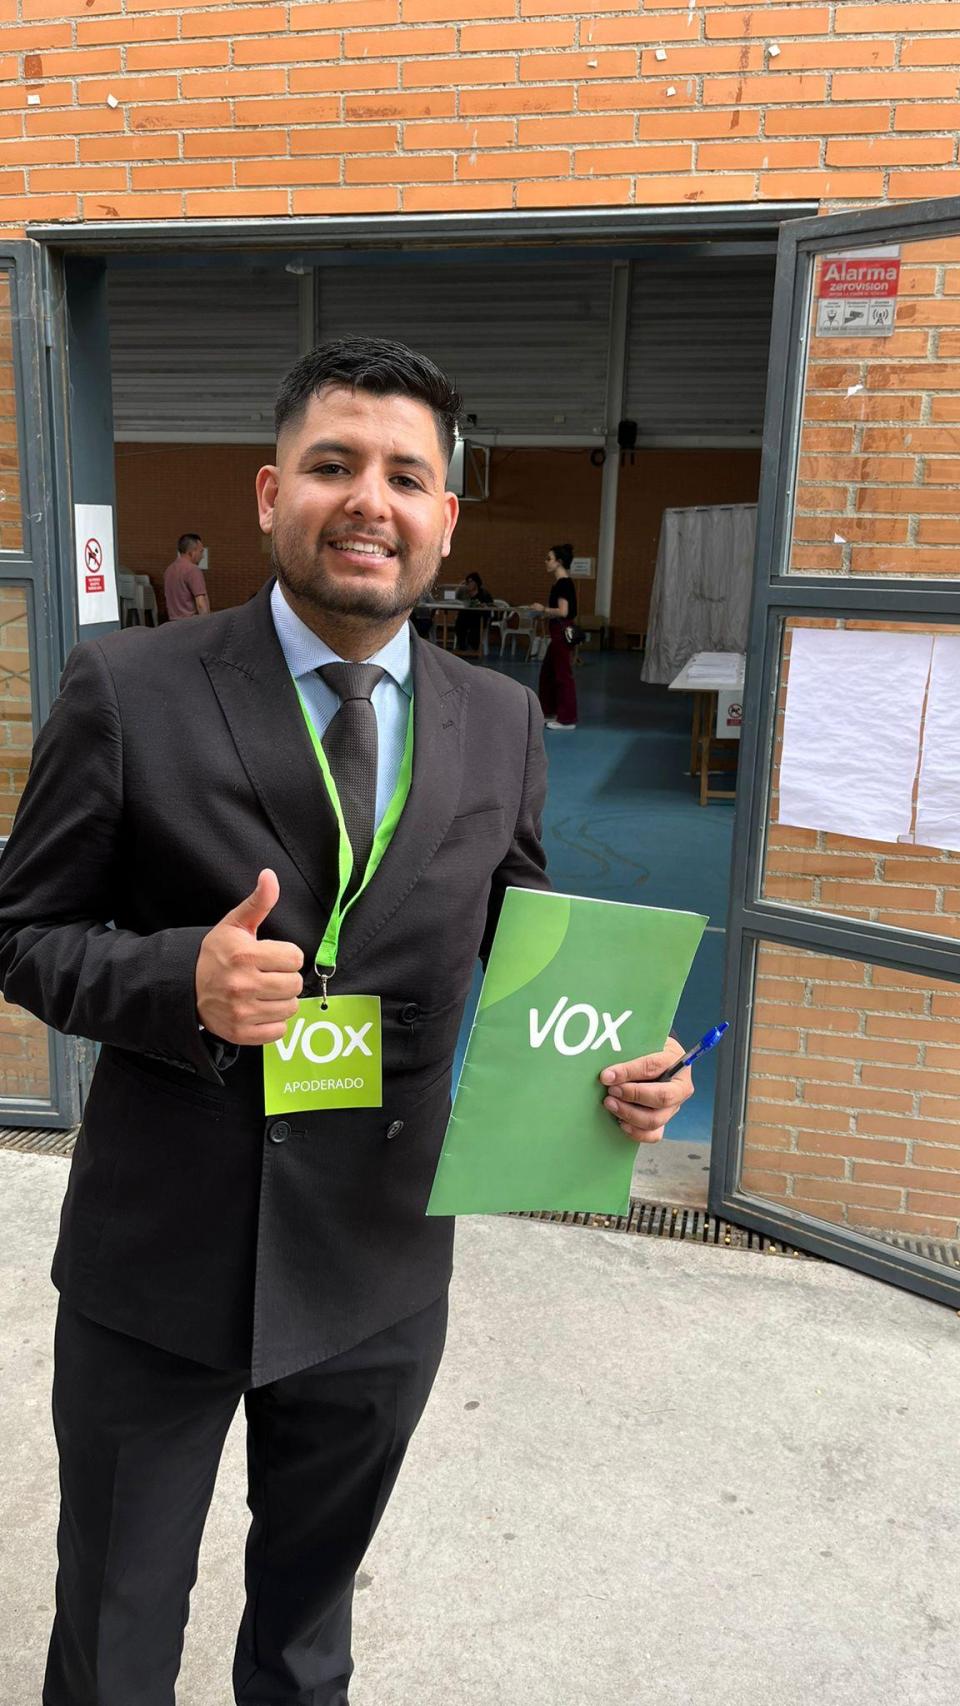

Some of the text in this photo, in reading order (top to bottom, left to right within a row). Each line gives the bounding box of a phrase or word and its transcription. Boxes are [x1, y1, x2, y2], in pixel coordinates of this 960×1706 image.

[824, 262, 897, 281] Alarma
[829, 282, 889, 291] zerovision
[529, 996, 633, 1056] VOX
[274, 1017, 374, 1064] VOX
[283, 1077, 365, 1094] APODERADO
